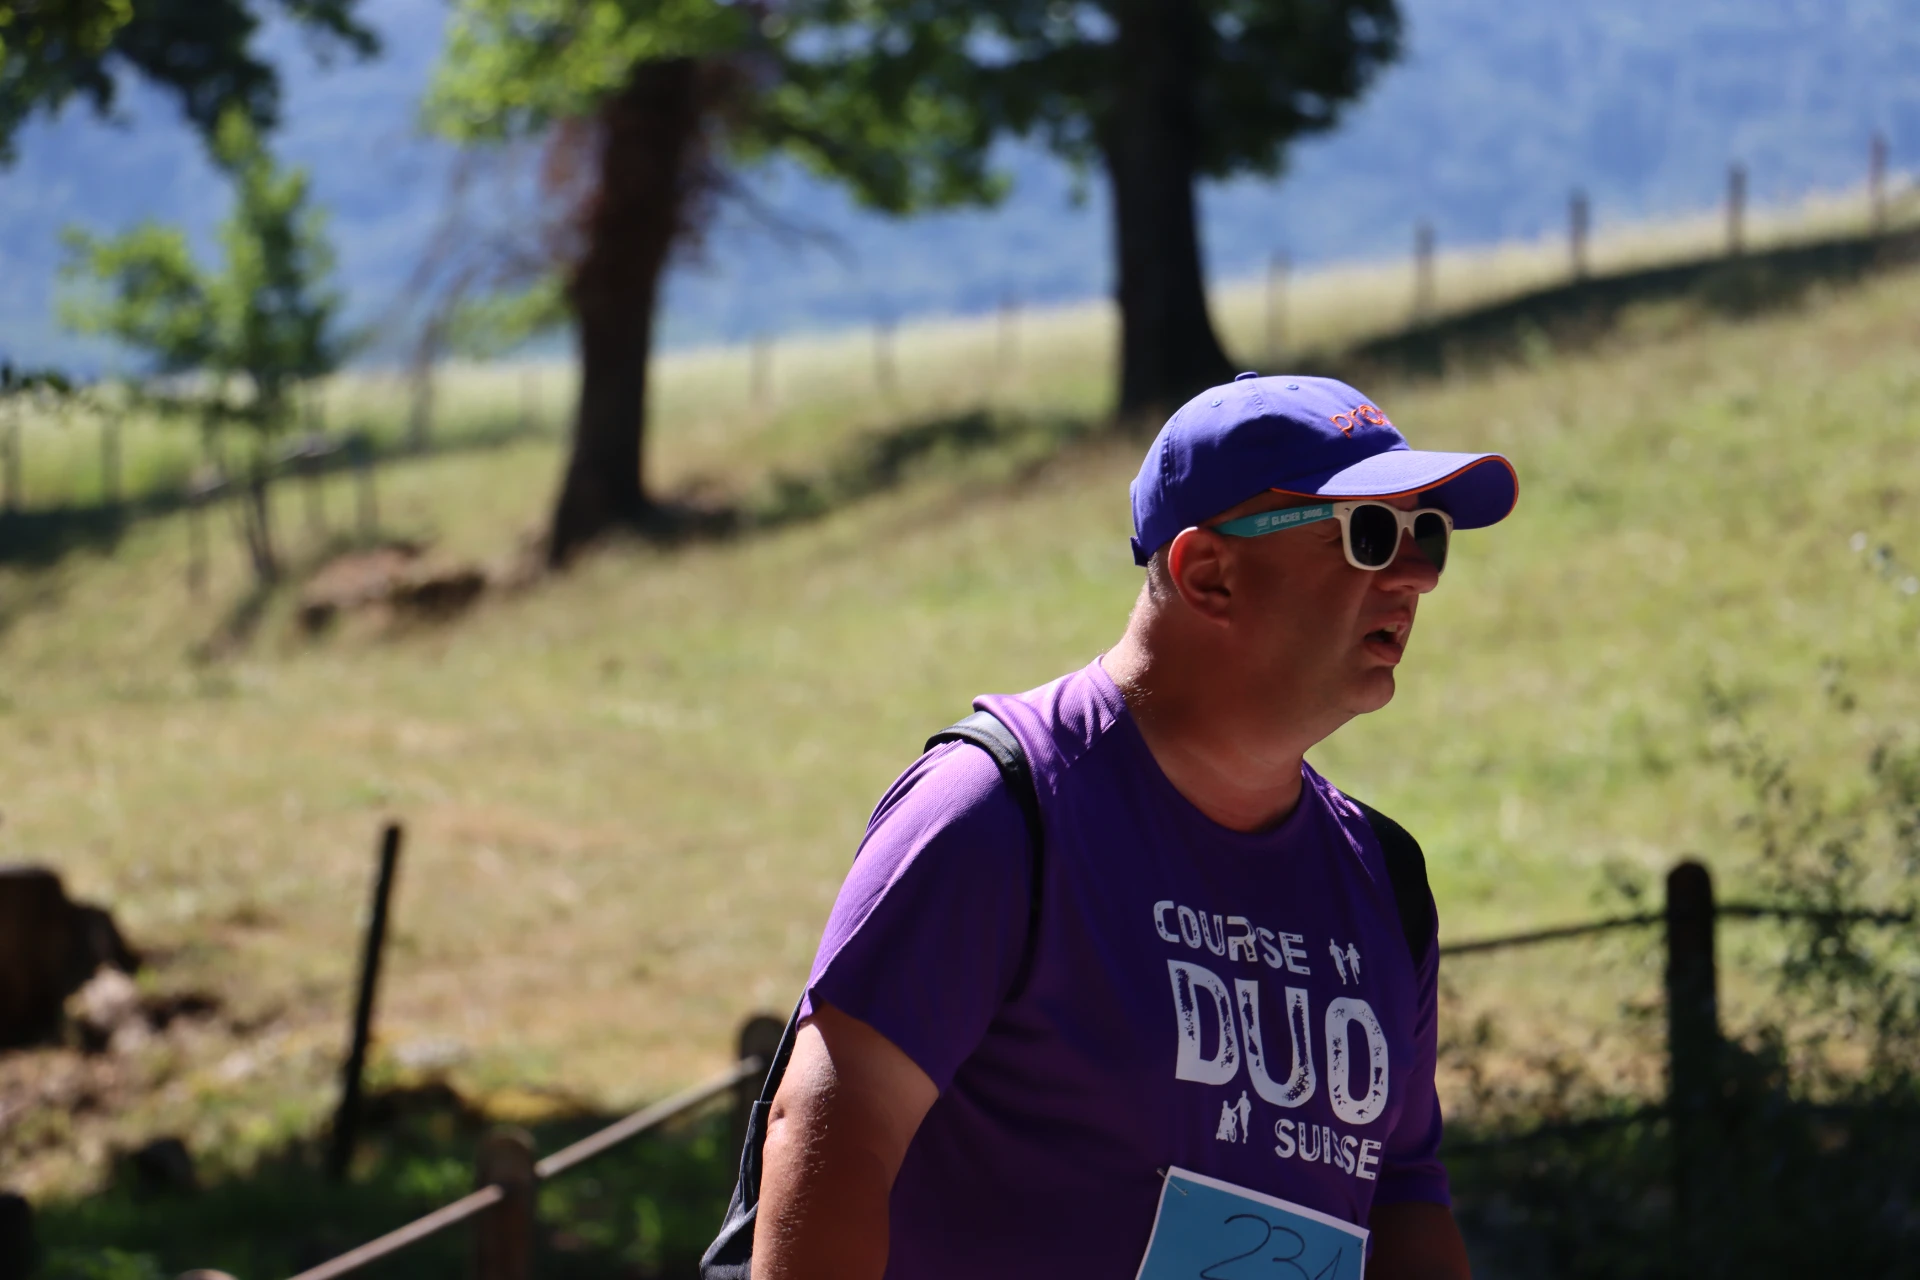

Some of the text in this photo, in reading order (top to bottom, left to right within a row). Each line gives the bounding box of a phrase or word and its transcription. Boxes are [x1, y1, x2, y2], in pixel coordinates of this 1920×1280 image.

[1328, 404, 1394, 439] pro
[1271, 512, 1300, 526] GLACIER
[1153, 900, 1311, 975] COURSE
[1166, 959, 1389, 1125] DUO
[1274, 1118, 1382, 1181] SUISSE
